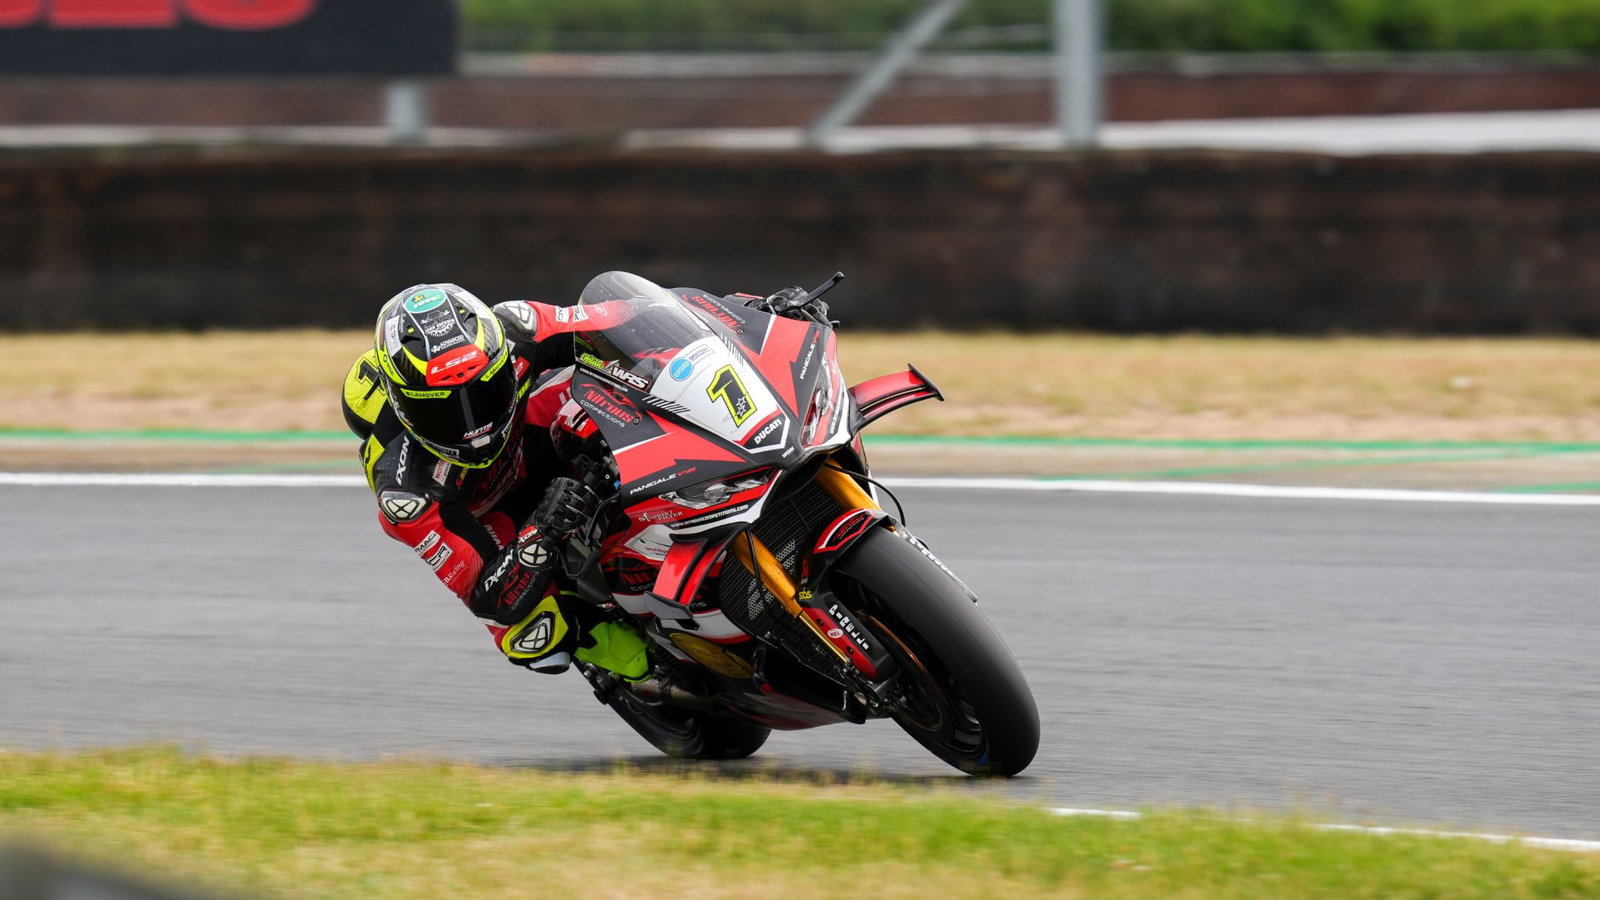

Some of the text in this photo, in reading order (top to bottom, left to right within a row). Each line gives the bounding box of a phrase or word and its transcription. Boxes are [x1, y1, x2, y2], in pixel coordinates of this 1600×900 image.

[612, 366, 650, 389] WRS
[706, 363, 758, 429] 1
[753, 418, 783, 445] DUCATI
[395, 434, 410, 486] IXON
[629, 473, 677, 495] PANIGALE
[828, 603, 870, 651] PIRELLI
